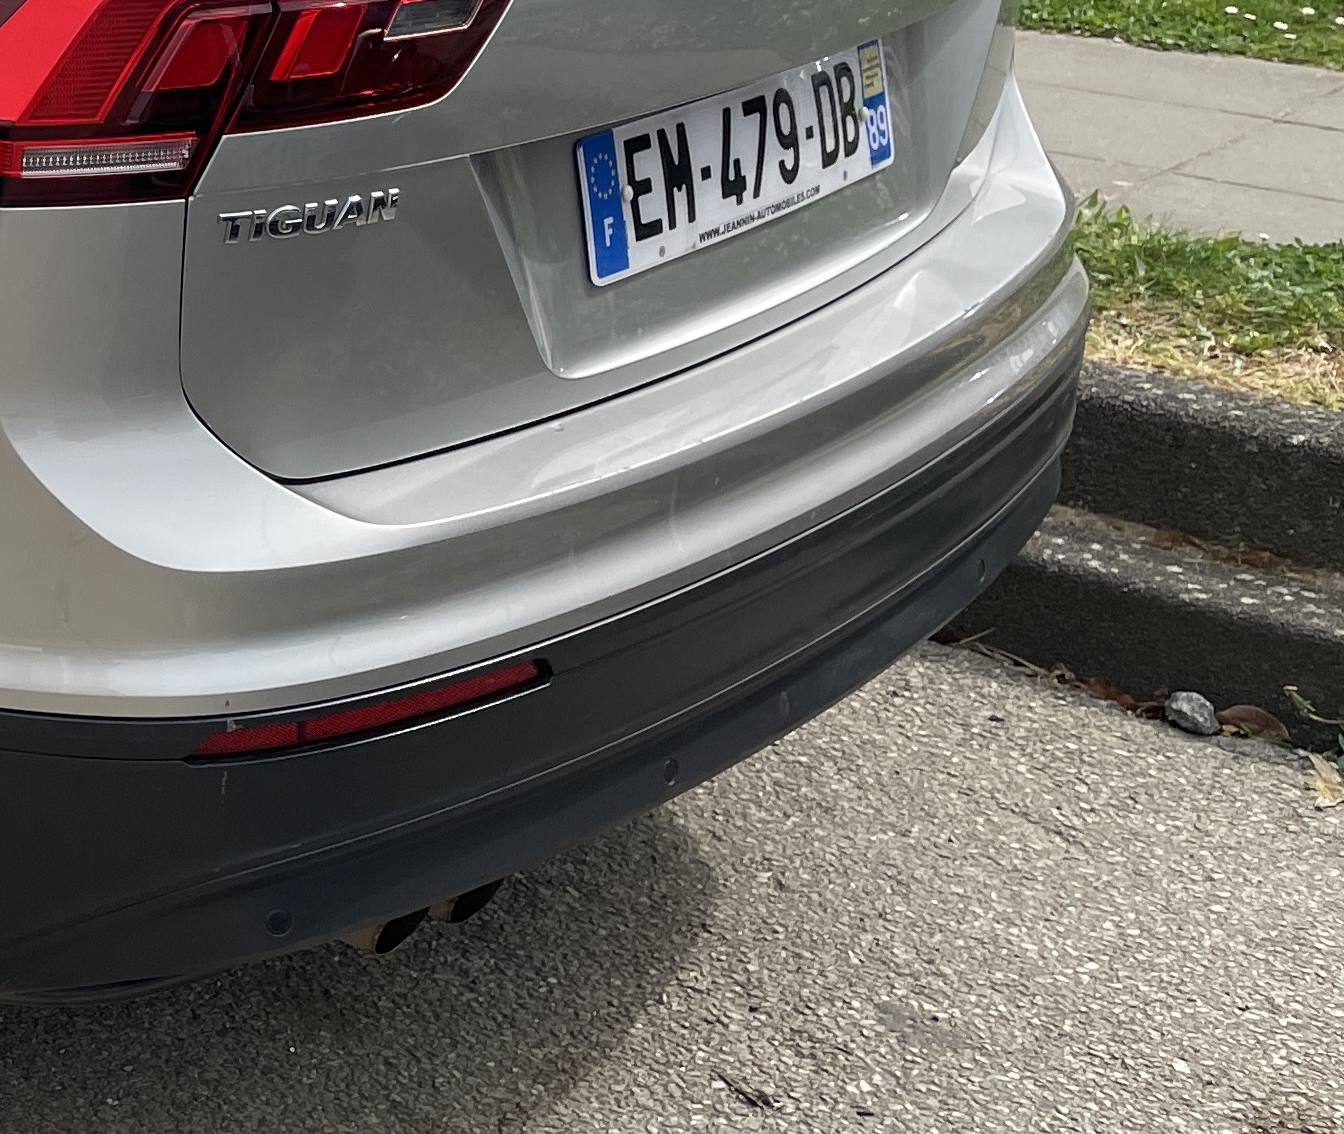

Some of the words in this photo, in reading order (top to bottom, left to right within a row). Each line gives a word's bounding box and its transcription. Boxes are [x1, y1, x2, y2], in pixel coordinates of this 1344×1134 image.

[623, 61, 860, 243] EM-479-DB
[867, 104, 889, 151] 89
[217, 187, 400, 244] TIGUAN
[603, 216, 615, 248] F
